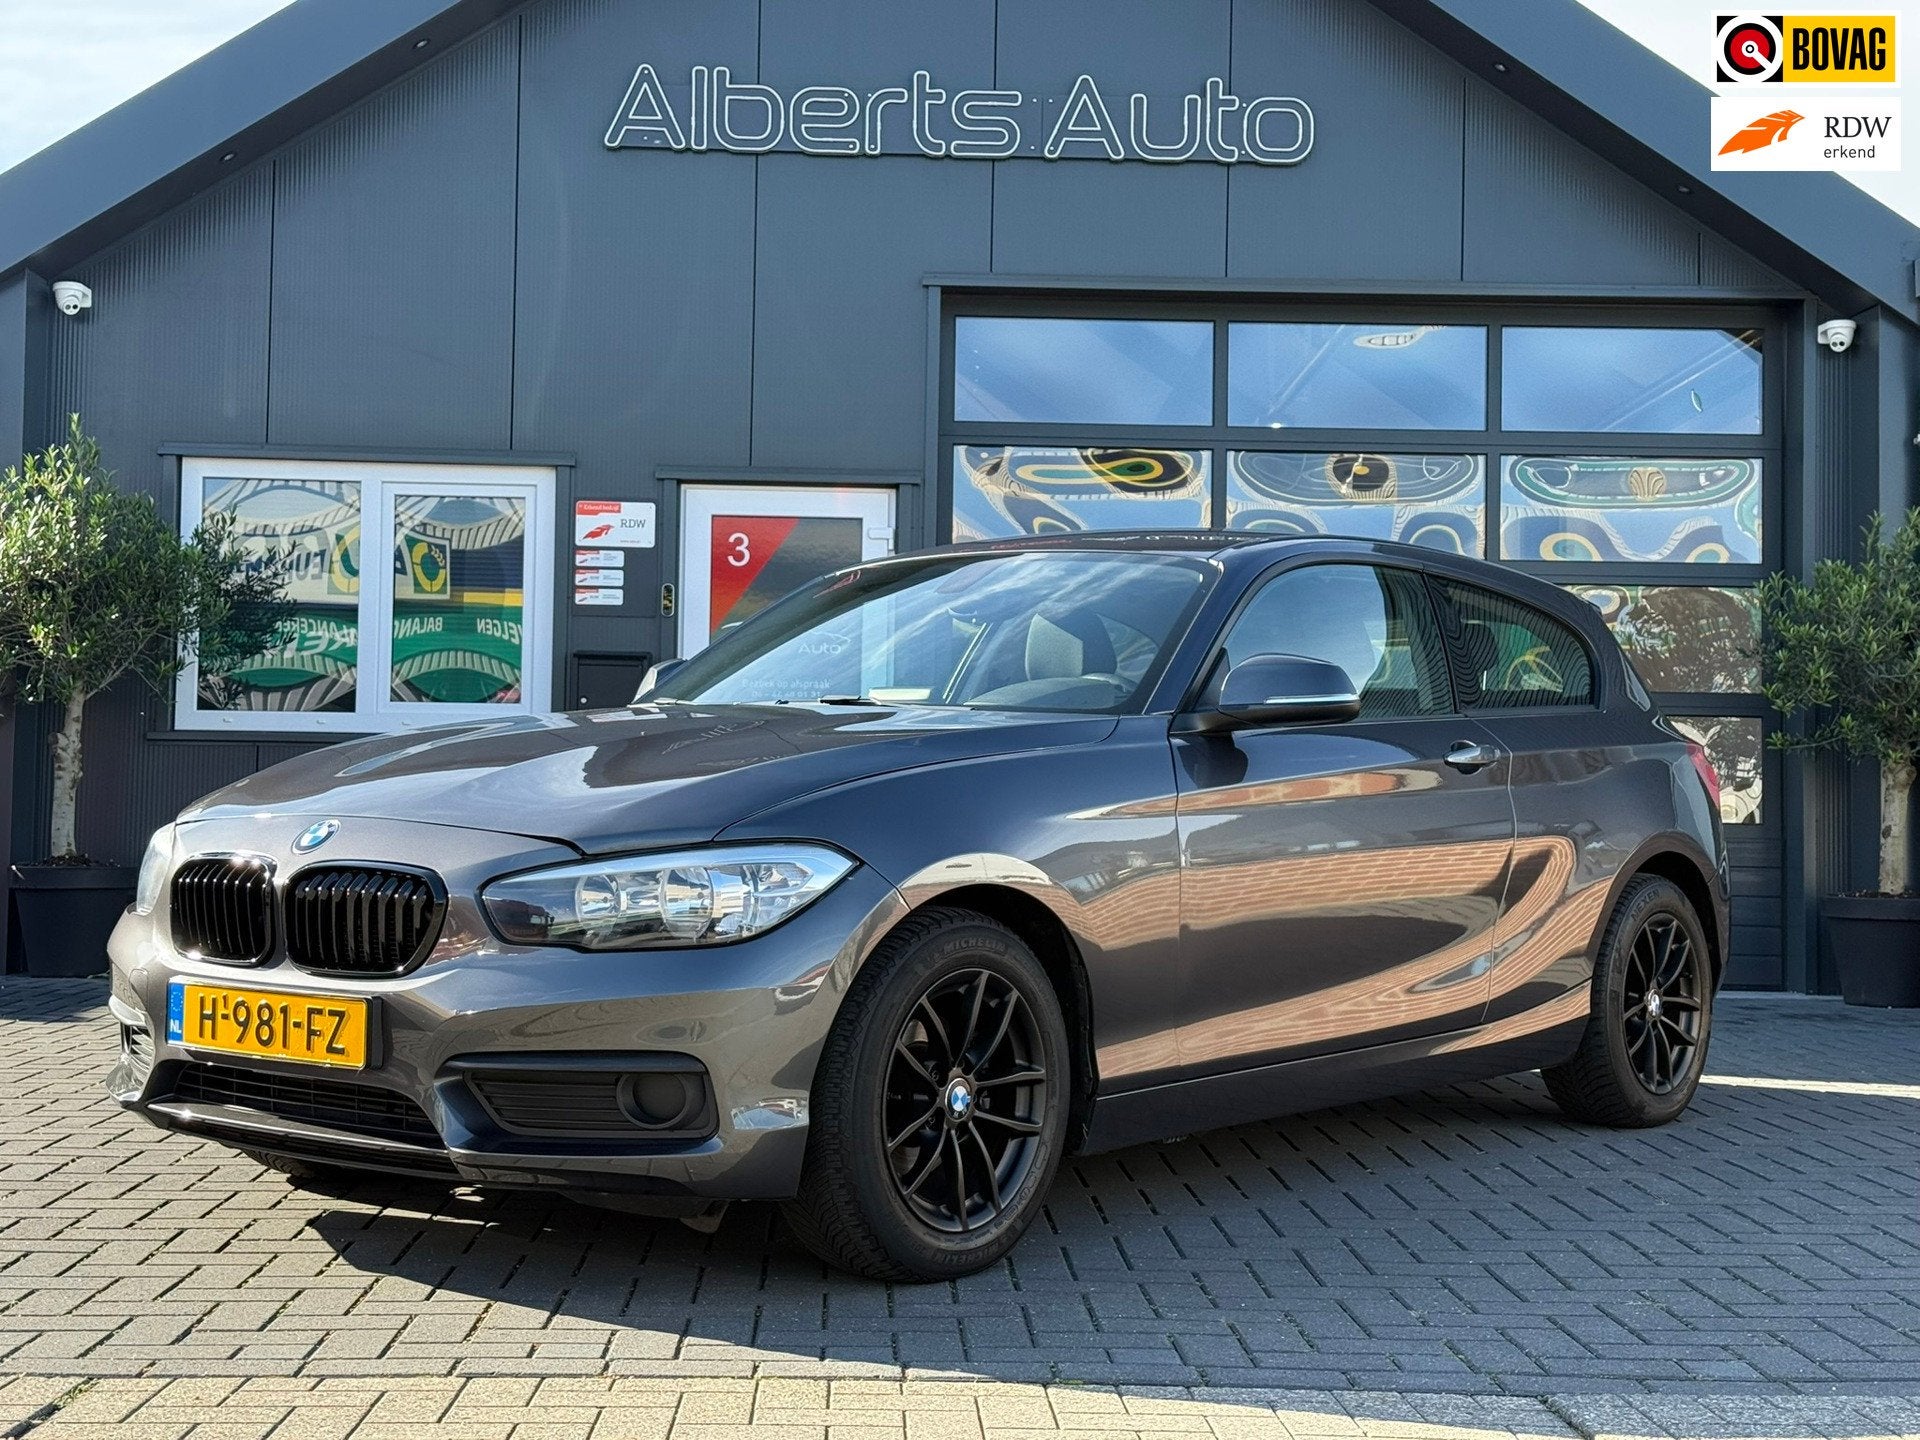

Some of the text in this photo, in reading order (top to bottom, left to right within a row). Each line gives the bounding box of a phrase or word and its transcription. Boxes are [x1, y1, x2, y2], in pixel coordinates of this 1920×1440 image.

[604, 63, 1315, 166] Alberts Auto
[620, 519, 646, 529] RDW
[727, 532, 750, 567] 3
[799, 641, 842, 655] Auto
[943, 936, 1006, 955] MICHELIN
[170, 1018, 182, 1034] NL
